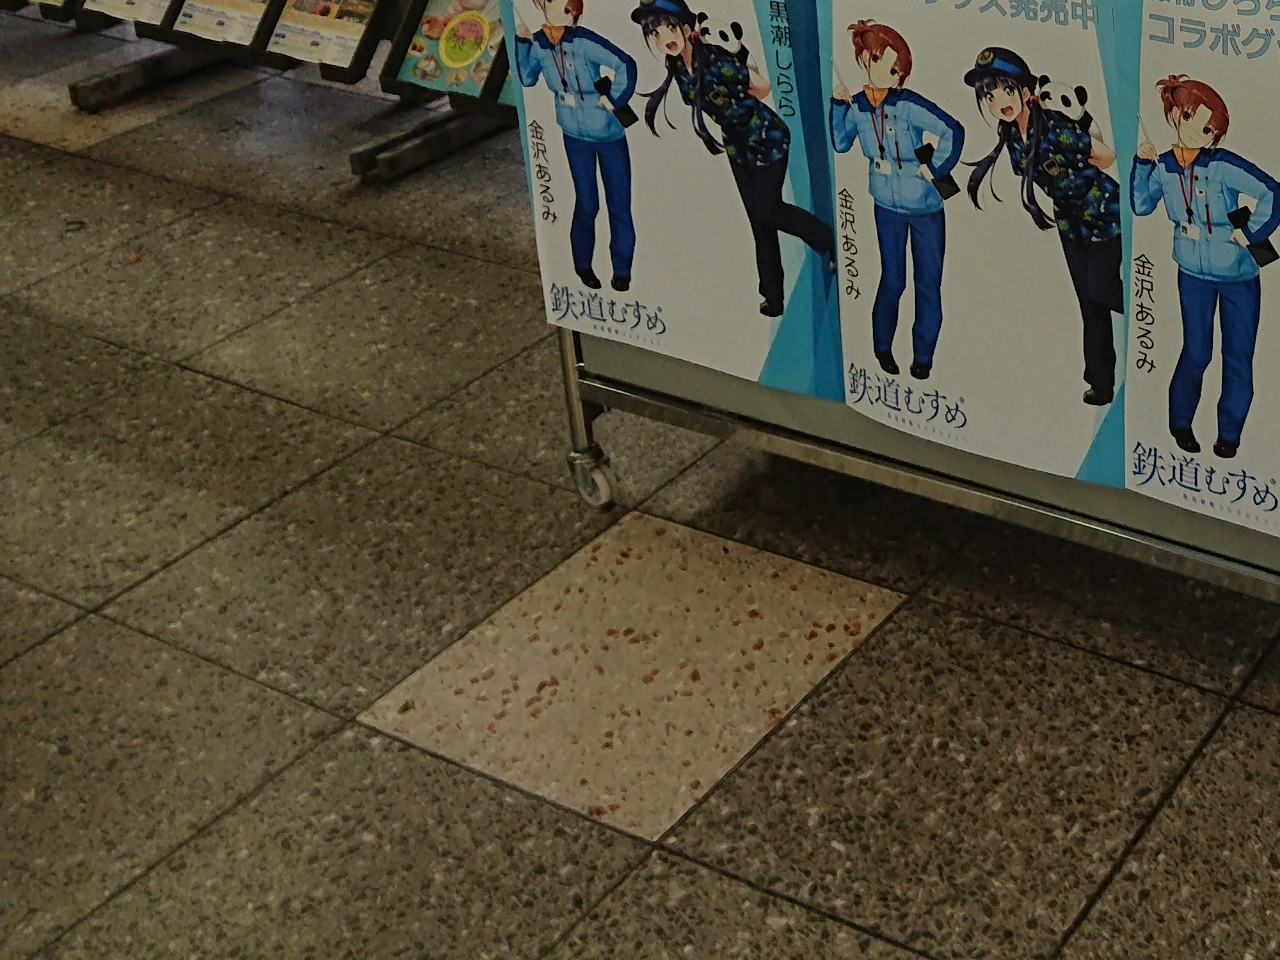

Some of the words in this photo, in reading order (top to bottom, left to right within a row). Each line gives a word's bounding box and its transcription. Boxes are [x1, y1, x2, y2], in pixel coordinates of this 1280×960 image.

[769, 0, 797, 118] 黒潮しらら
[528, 119, 559, 224] 金沢あるみ
[838, 187, 861, 300] 金沢あるみ
[550, 282, 667, 335] 鉄道むすめ
[1133, 253, 1157, 374] 金沢あるみ
[848, 362, 968, 429] 鉄道むすめ
[1132, 441, 1280, 512] 鉄道むすめ
